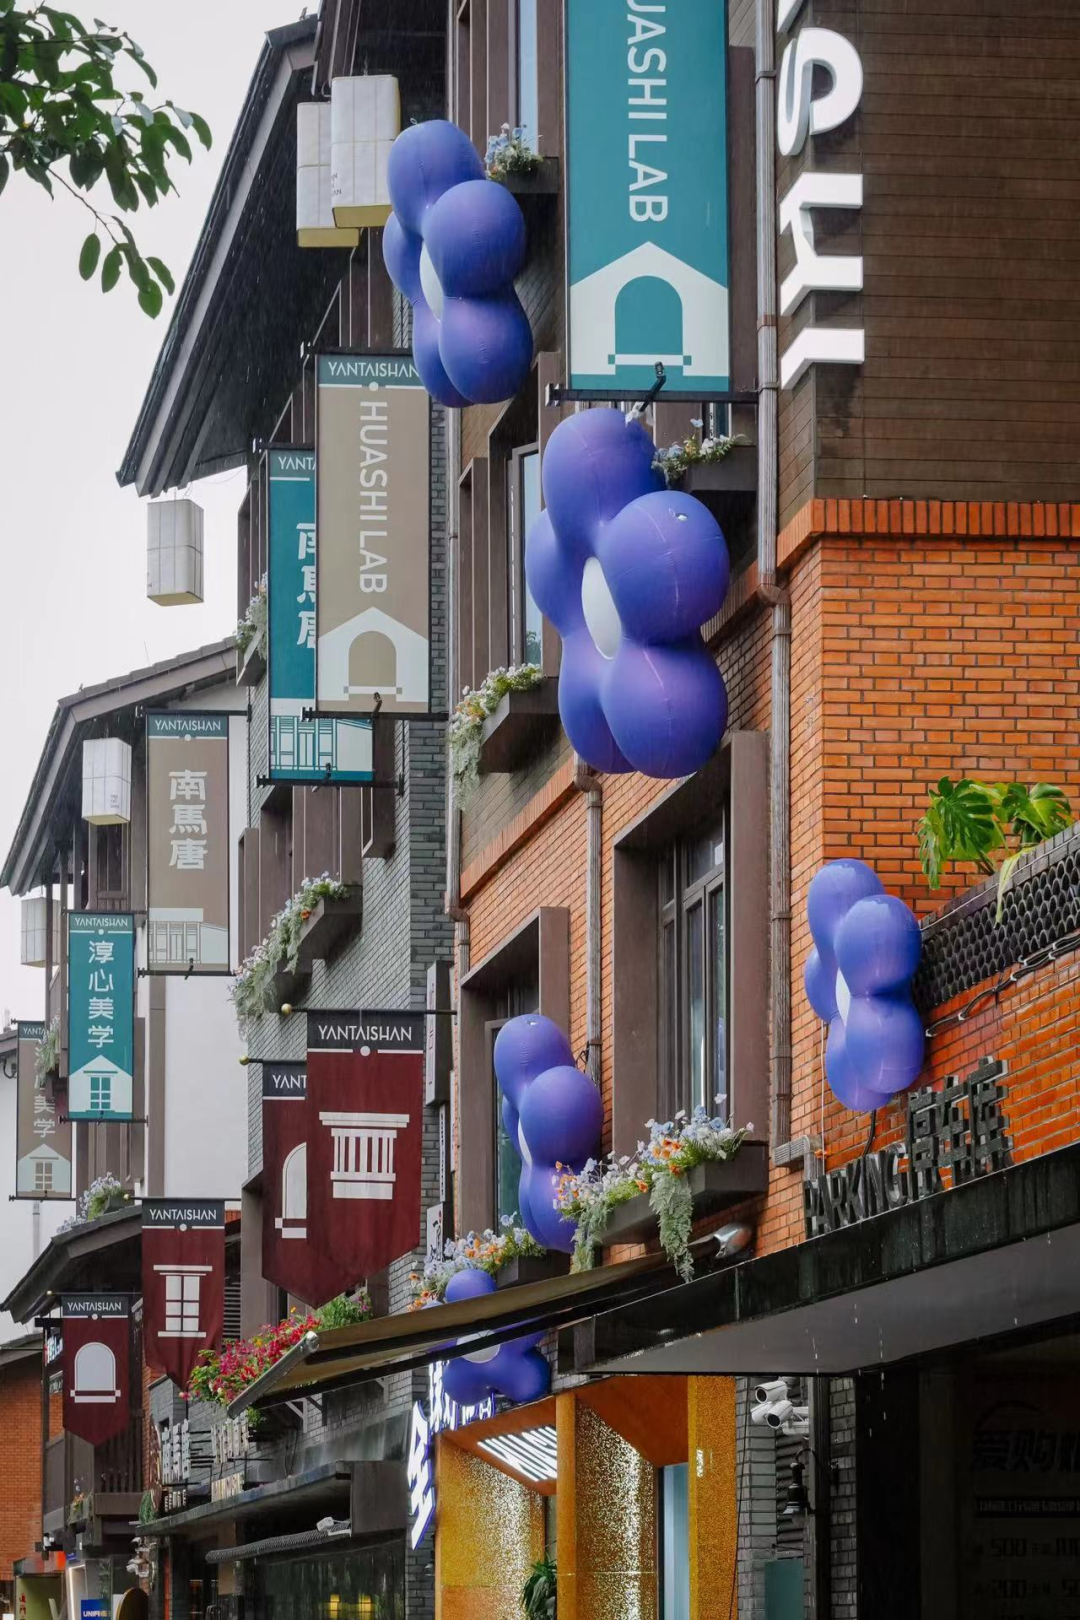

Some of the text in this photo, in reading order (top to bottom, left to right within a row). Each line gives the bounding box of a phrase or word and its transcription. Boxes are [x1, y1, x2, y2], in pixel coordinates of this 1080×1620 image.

[628, 134, 669, 222] LAB
[777, 0, 864, 390] SHI
[328, 361, 421, 378] YANTAISHAN
[359, 401, 388, 594] HUASHI LAB
[155, 719, 221, 731] YANTAISHAN
[168, 769, 208, 870] 南馬唐
[75, 917, 128, 927] YANTAISHAN
[88, 941, 114, 1048] 淳心美学
[318, 1025, 412, 1042] YANTAISHAN
[149, 1208, 217, 1221] YANTAISHAN
[67, 1301, 122, 1312] YANTAISHAN
